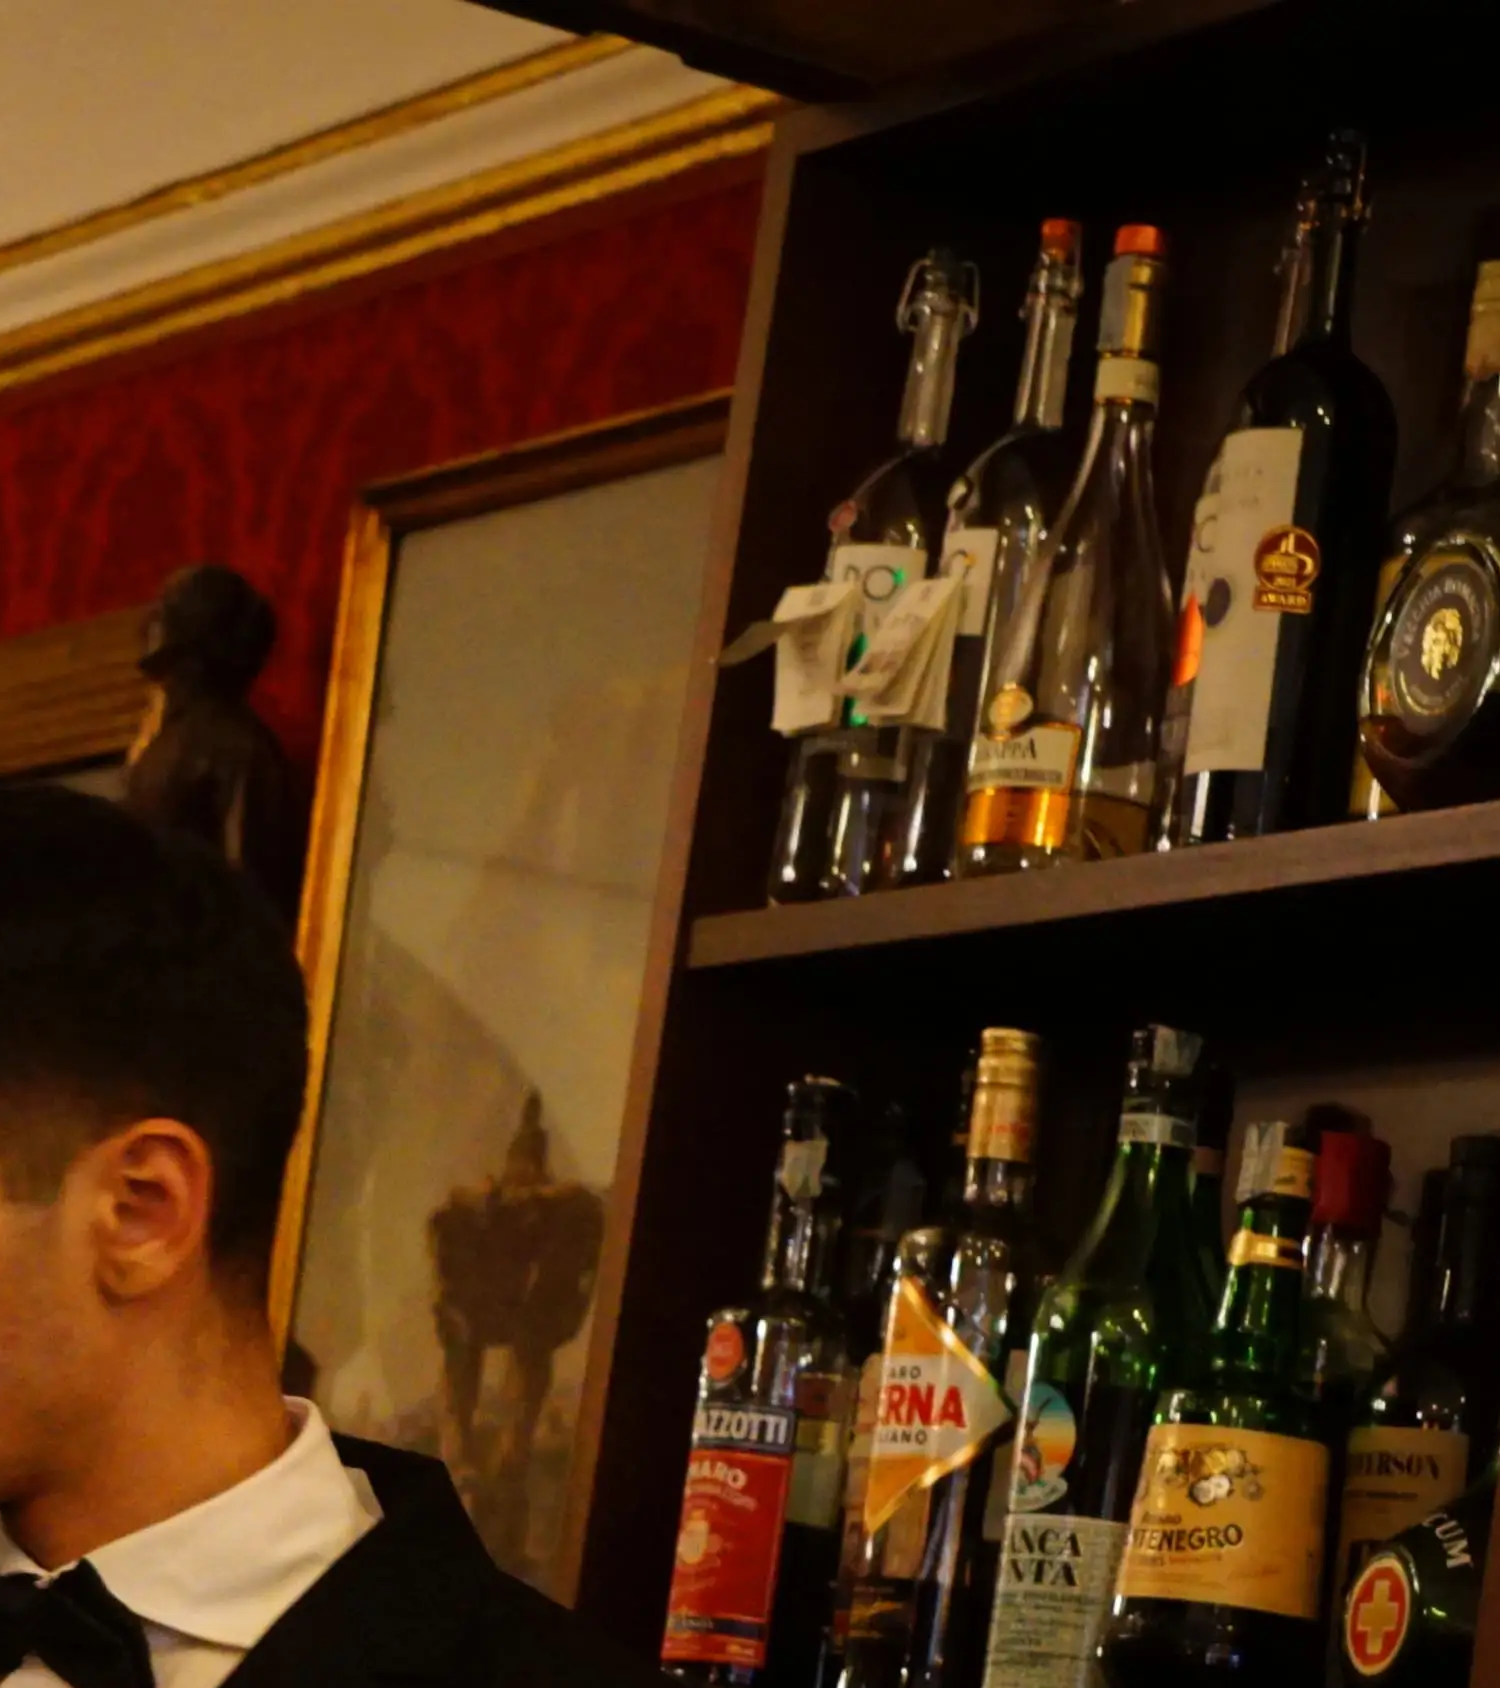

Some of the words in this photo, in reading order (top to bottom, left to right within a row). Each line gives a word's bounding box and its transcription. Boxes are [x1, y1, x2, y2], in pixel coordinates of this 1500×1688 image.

[889, 1366, 922, 1380] ARO
[884, 1383, 968, 1429] RNA
[698, 1408, 790, 1446] AZZOTTI
[691, 1459, 750, 1491] MARO
[1421, 1511, 1476, 1570] CUM
